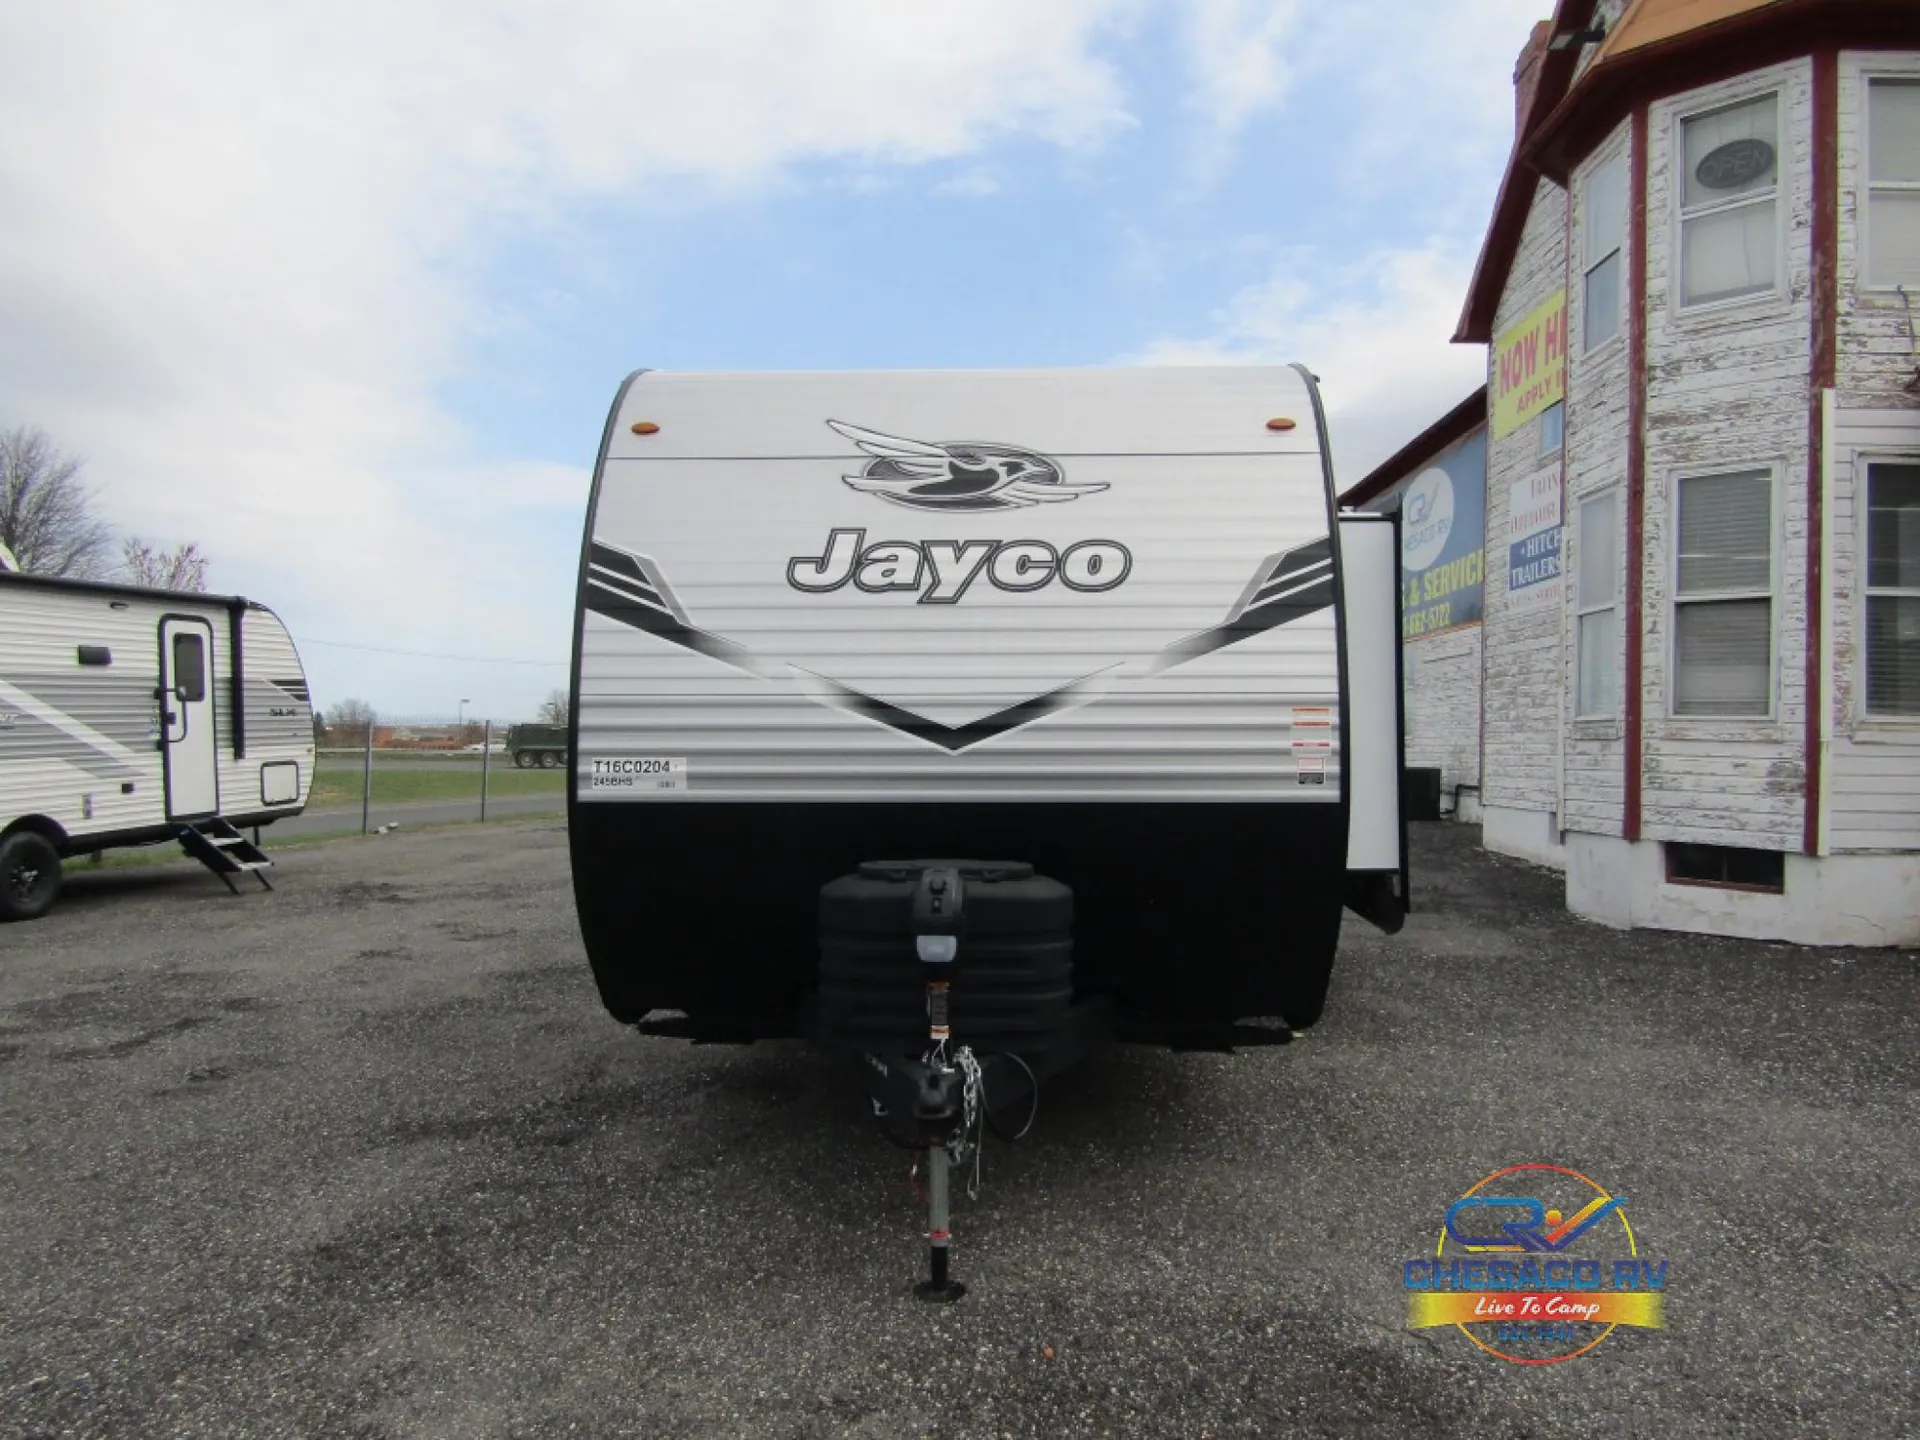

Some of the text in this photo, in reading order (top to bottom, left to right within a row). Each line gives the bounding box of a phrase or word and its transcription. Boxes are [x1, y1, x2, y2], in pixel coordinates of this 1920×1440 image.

[1700, 145, 1767, 181] OPEN
[1500, 305, 1567, 398] NOW HI
[1516, 375, 1551, 415] APPLY
[786, 528, 1132, 604] Jayco
[593, 760, 671, 774] T16C0204
